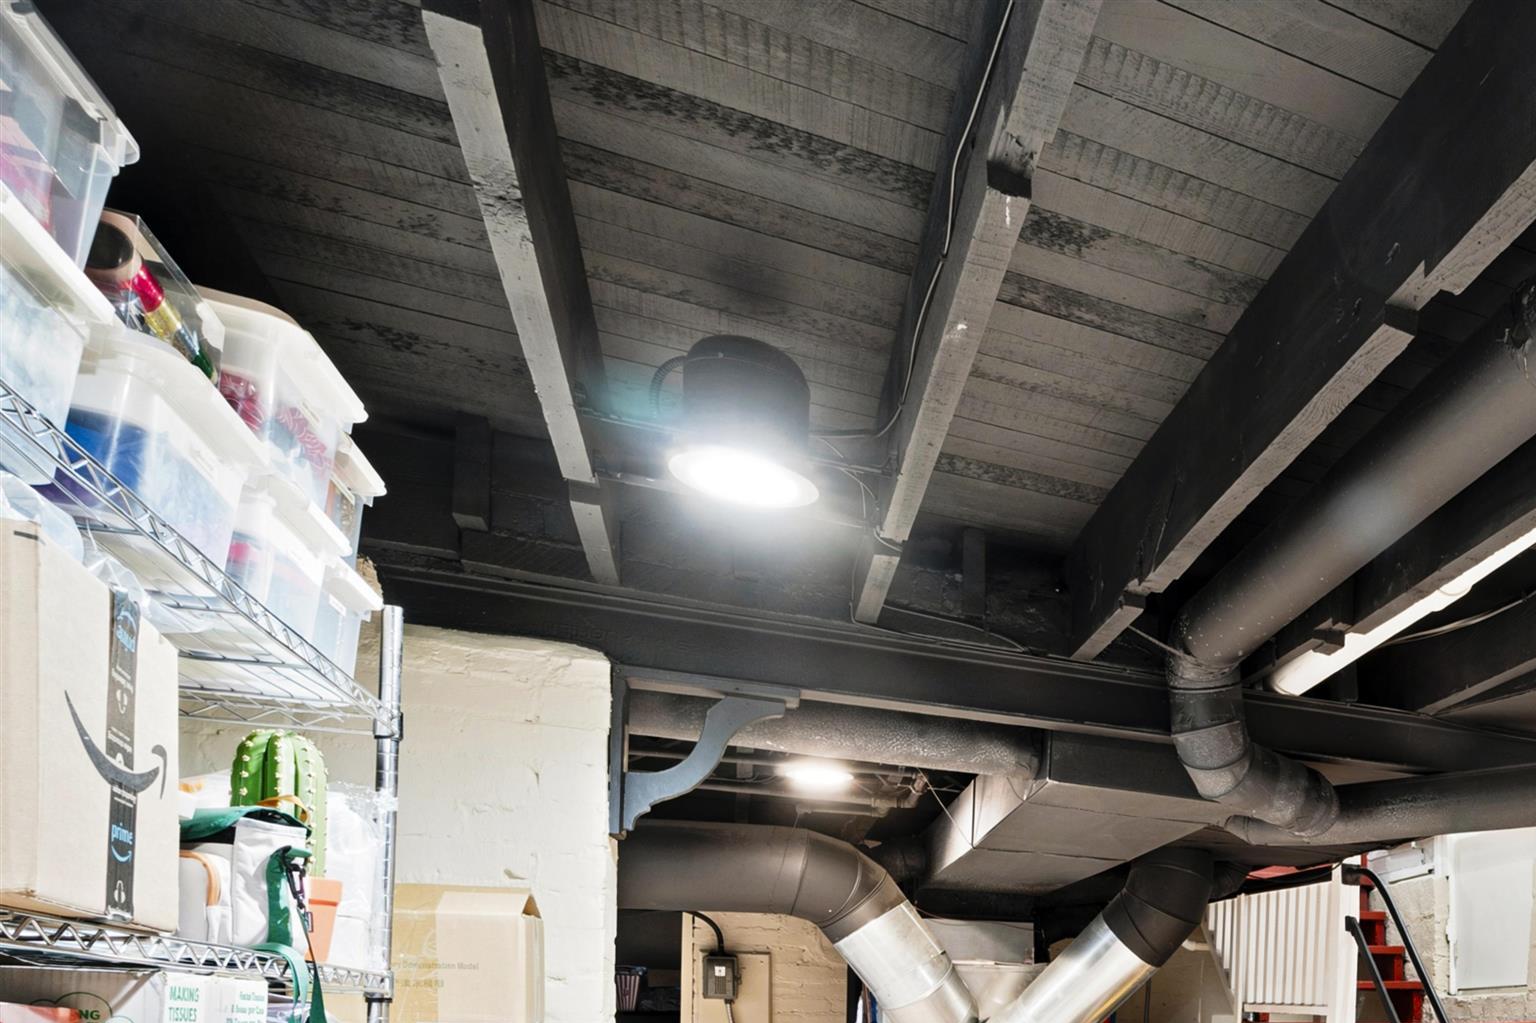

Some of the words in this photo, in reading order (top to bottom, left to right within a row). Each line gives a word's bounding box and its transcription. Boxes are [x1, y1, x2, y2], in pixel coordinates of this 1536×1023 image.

[111, 823, 133, 845] prime
[170, 986, 199, 1002] MAKING
[168, 1007, 197, 1022] TISSUES
